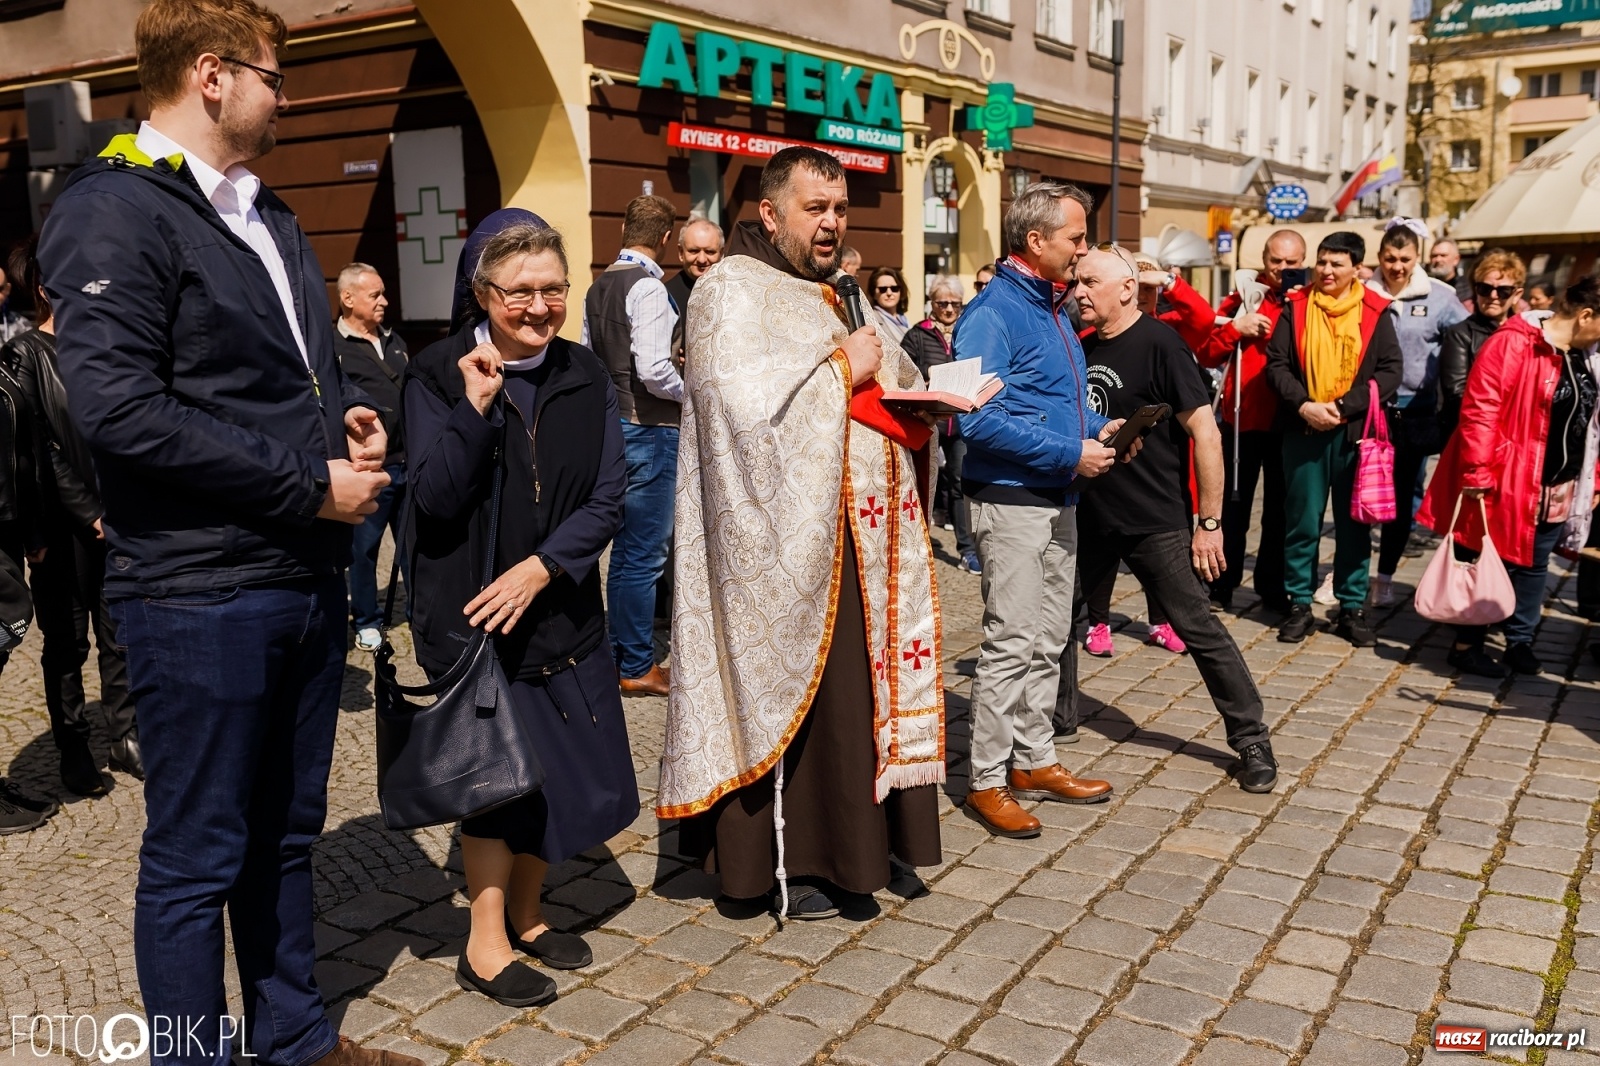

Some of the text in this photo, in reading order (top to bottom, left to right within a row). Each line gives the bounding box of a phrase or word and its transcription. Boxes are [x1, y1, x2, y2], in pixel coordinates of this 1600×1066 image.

[637, 21, 901, 128] APTEKA
[680, 127, 724, 149] RYNEK
[726, 134, 741, 150] 12
[828, 124, 901, 148] POD RÓŻAMI
[81, 279, 111, 295] 4F
